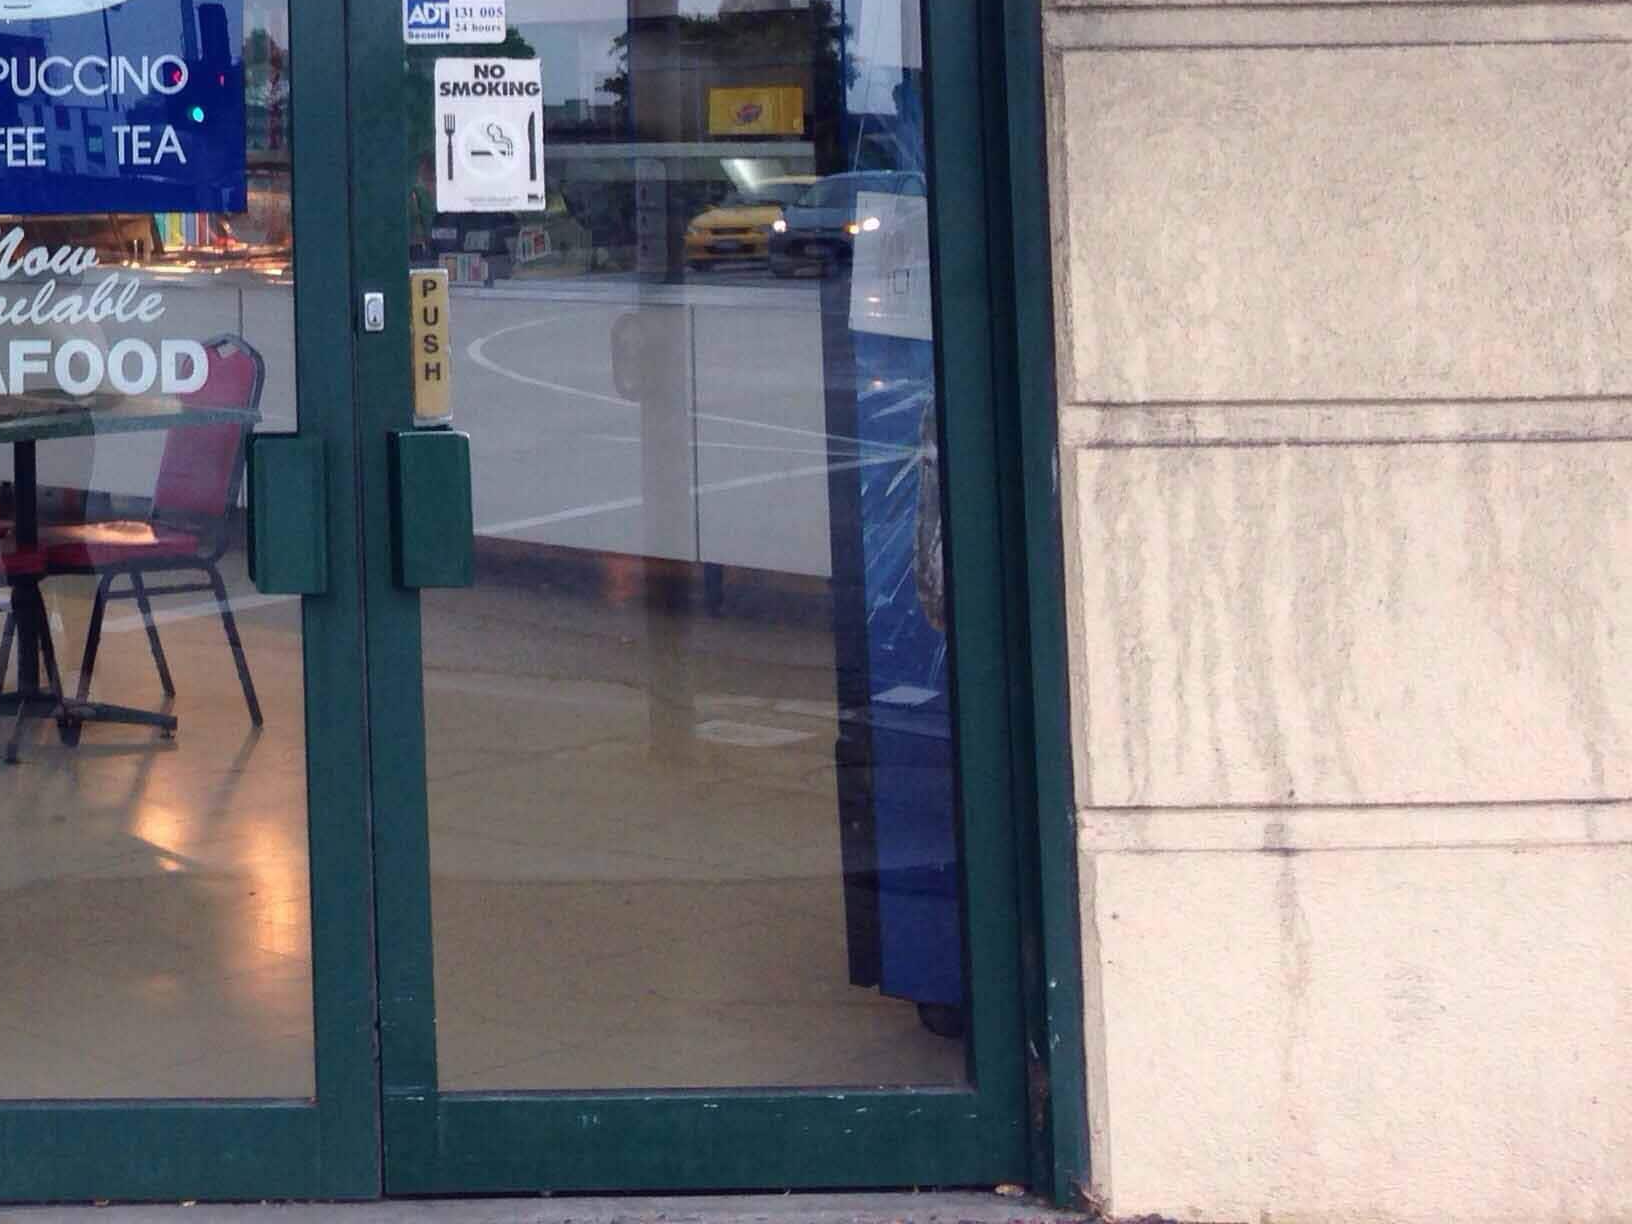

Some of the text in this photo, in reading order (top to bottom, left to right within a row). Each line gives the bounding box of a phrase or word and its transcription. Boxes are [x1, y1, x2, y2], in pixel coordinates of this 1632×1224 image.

[409, 2, 450, 25] ADT
[454, 6, 504, 18] 131 005
[455, 22, 502, 33] 24 hours
[408, 31, 450, 41] Security
[473, 64, 506, 80] NO
[439, 81, 541, 97] SMOKING
[112, 124, 187, 165] TEA
[421, 278, 442, 382] PUSH
